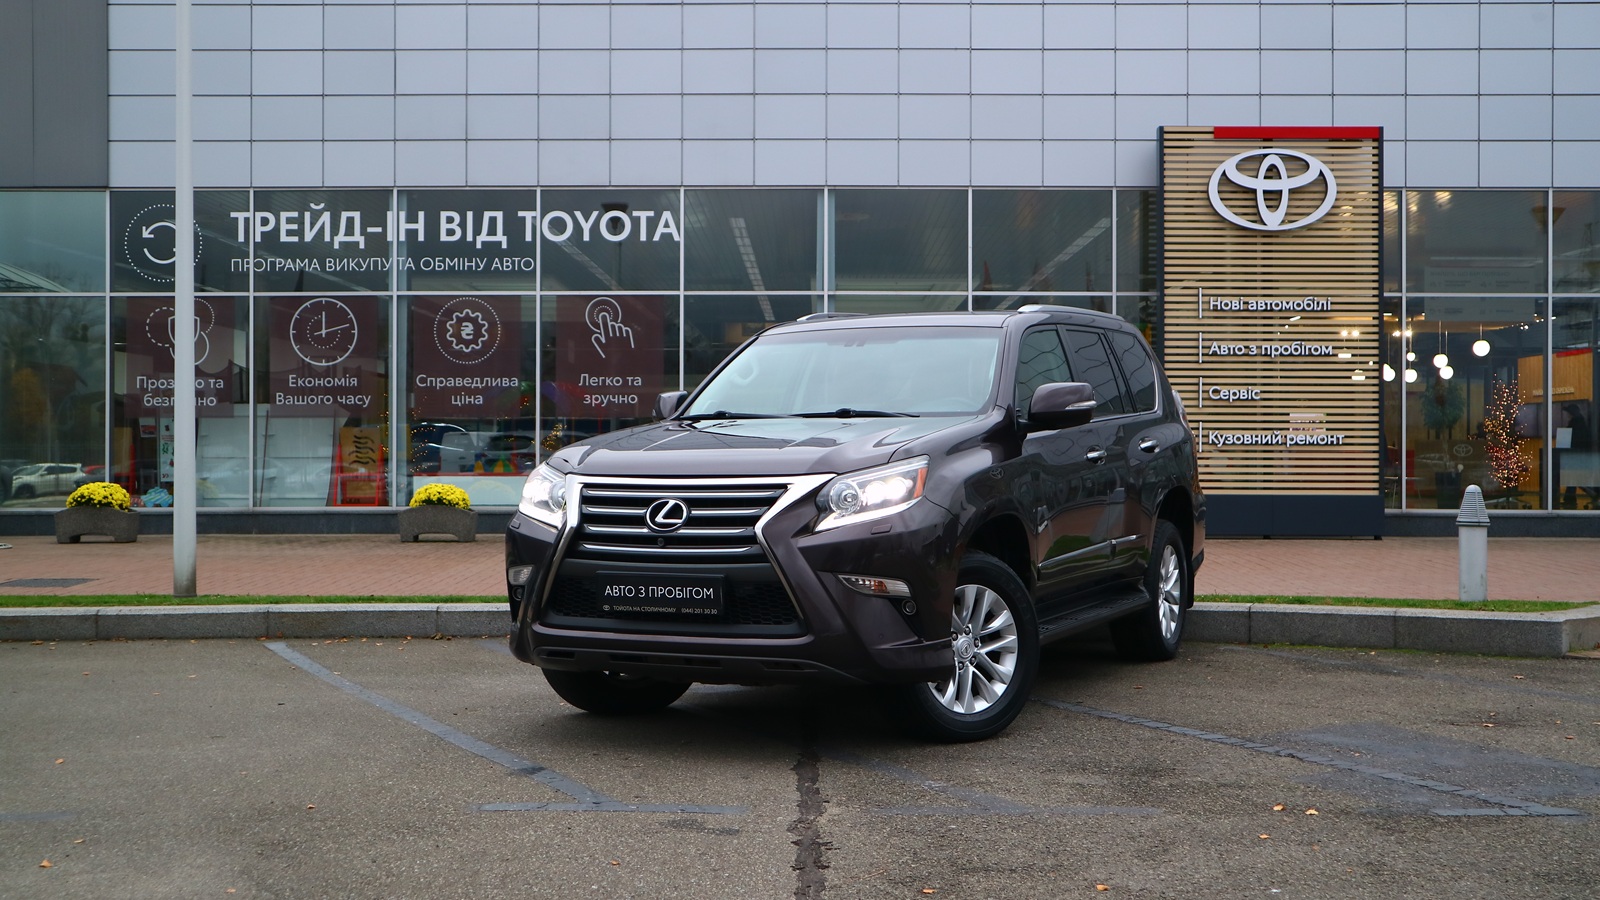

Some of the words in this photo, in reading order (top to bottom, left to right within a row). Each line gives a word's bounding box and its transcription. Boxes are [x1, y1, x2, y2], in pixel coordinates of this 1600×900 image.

[230, 203, 425, 249] ТРЕЙД-ІН
[440, 210, 507, 249] ВІД
[518, 210, 680, 242] TOYOTA
[231, 257, 321, 272] ПРОГРАМА
[326, 257, 393, 272] ВИКУПУ
[397, 257, 415, 271] ТА
[420, 257, 487, 271] ОБМІНУ
[490, 257, 535, 271] АВТО
[1209, 296, 1244, 311] Нові
[1248, 296, 1331, 311] автомобілі
[1209, 342, 1245, 356] Авто
[1249, 345, 1257, 356] з
[1261, 342, 1333, 358] пробігом
[136, 376, 205, 391] Прозо
[208, 378, 224, 389] та
[288, 375, 358, 388] Економія
[416, 375, 519, 389] Справедлива
[578, 374, 622, 387] Легко
[626, 376, 642, 387] та
[276, 393, 333, 405] Вашого
[337, 395, 371, 407] часу
[451, 392, 483, 407] ціна
[583, 393, 638, 408] зручно
[1209, 386, 1261, 402] Сервіс
[1209, 431, 1282, 447] Кузовний
[1286, 433, 1345, 447] ремонт
[604, 585, 635, 597] АВТО
[638, 586, 645, 598] З
[648, 586, 714, 599] ПРОБІГОМ
